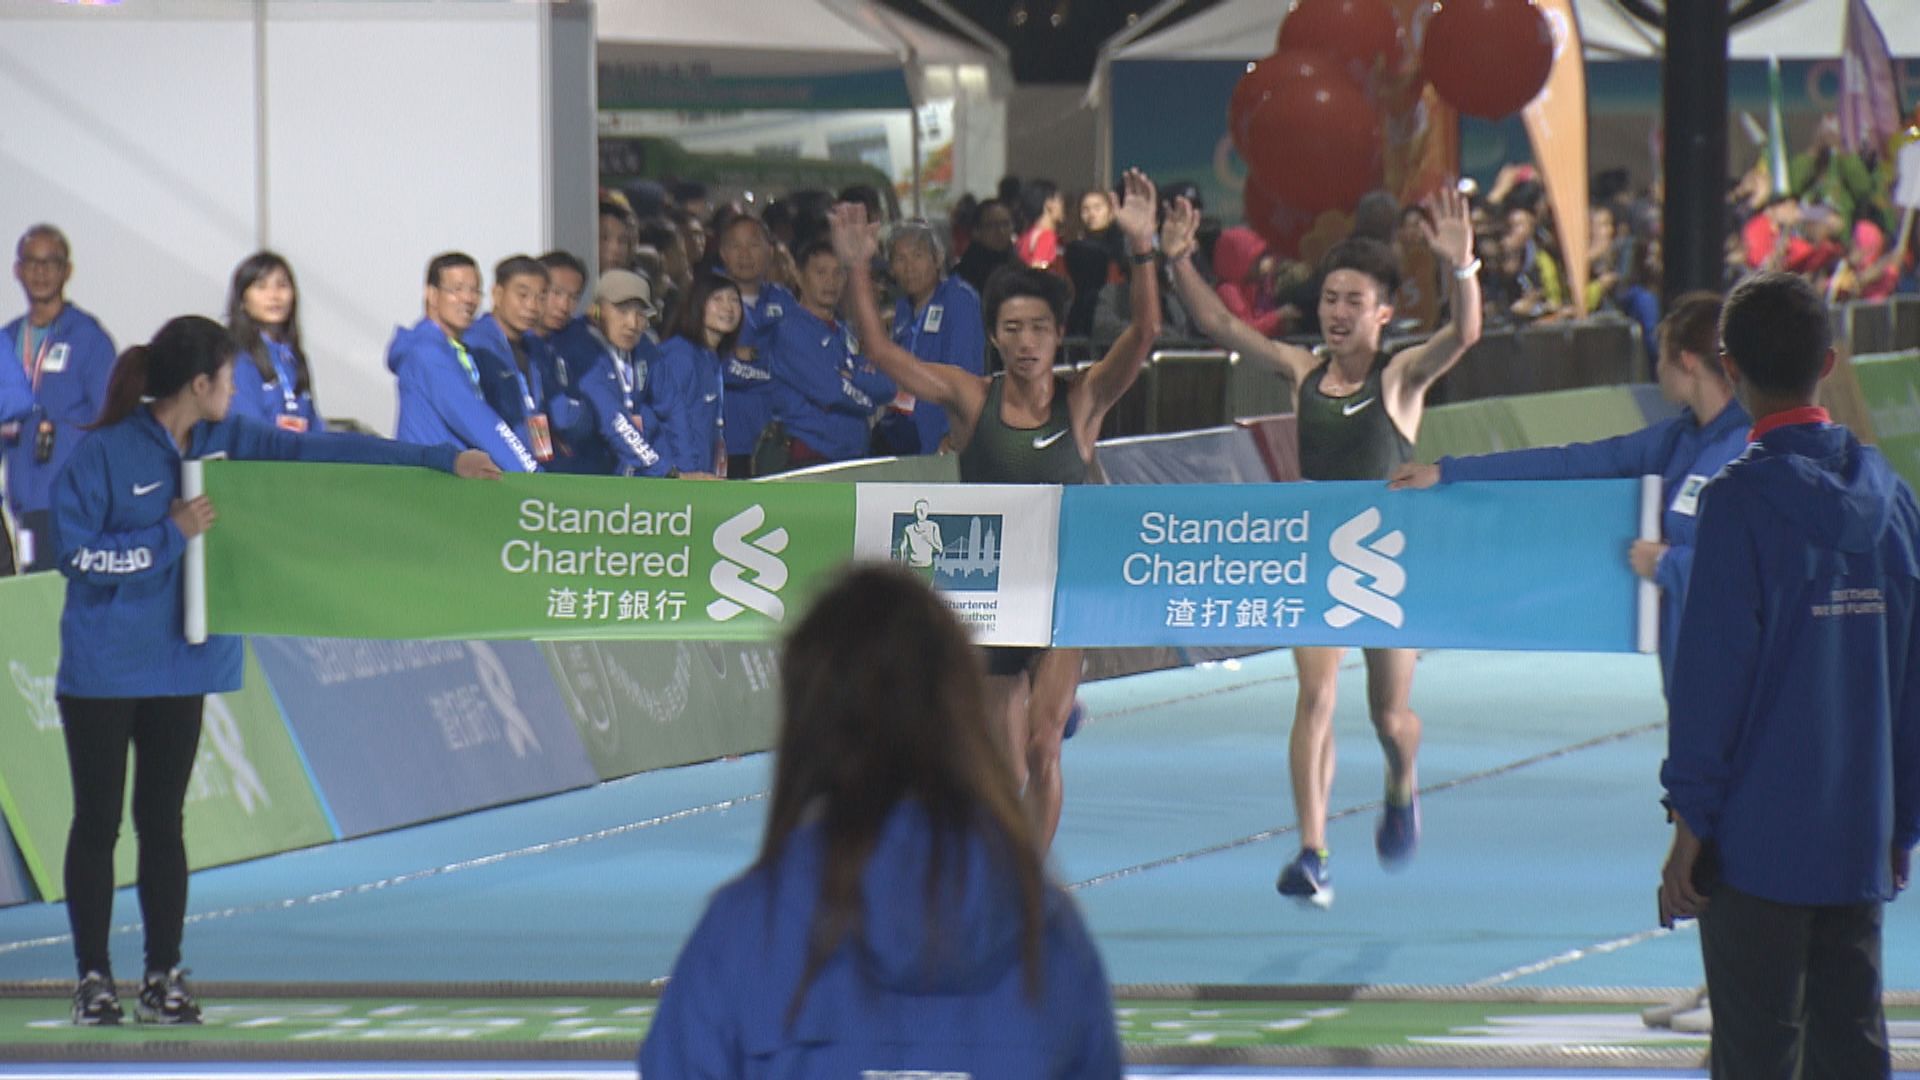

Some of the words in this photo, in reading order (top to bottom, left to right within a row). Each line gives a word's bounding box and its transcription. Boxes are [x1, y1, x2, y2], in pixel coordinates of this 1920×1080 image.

[519, 499, 692, 536] Standard
[1140, 510, 1310, 544] Standard
[501, 539, 690, 577] Chartered
[1123, 552, 1307, 585] Chartered
[547, 587, 687, 622] 渣打銀行
[1165, 597, 1305, 628] 渣打銀行
